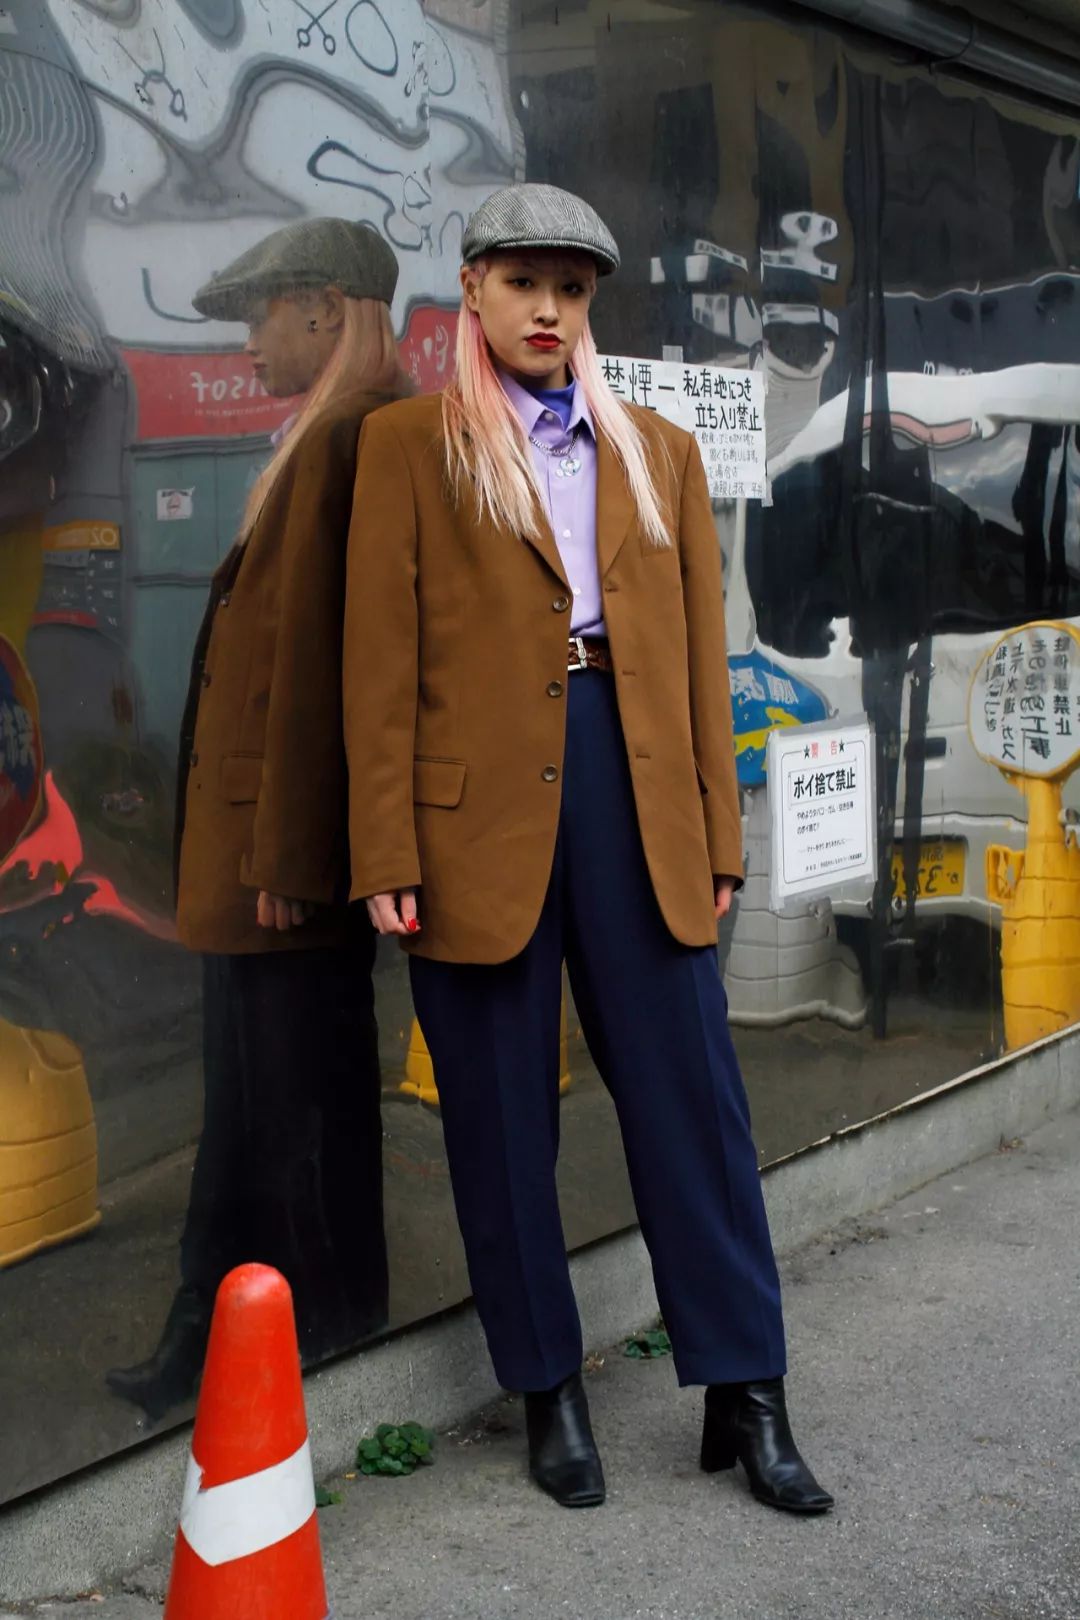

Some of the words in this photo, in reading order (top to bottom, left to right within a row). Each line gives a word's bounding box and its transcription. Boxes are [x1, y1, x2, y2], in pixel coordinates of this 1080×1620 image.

[683, 368, 751, 401] 私有地につき
[695, 402, 762, 431] 立ち入り禁止
[794, 766, 856, 799] ポイ捨て禁止
